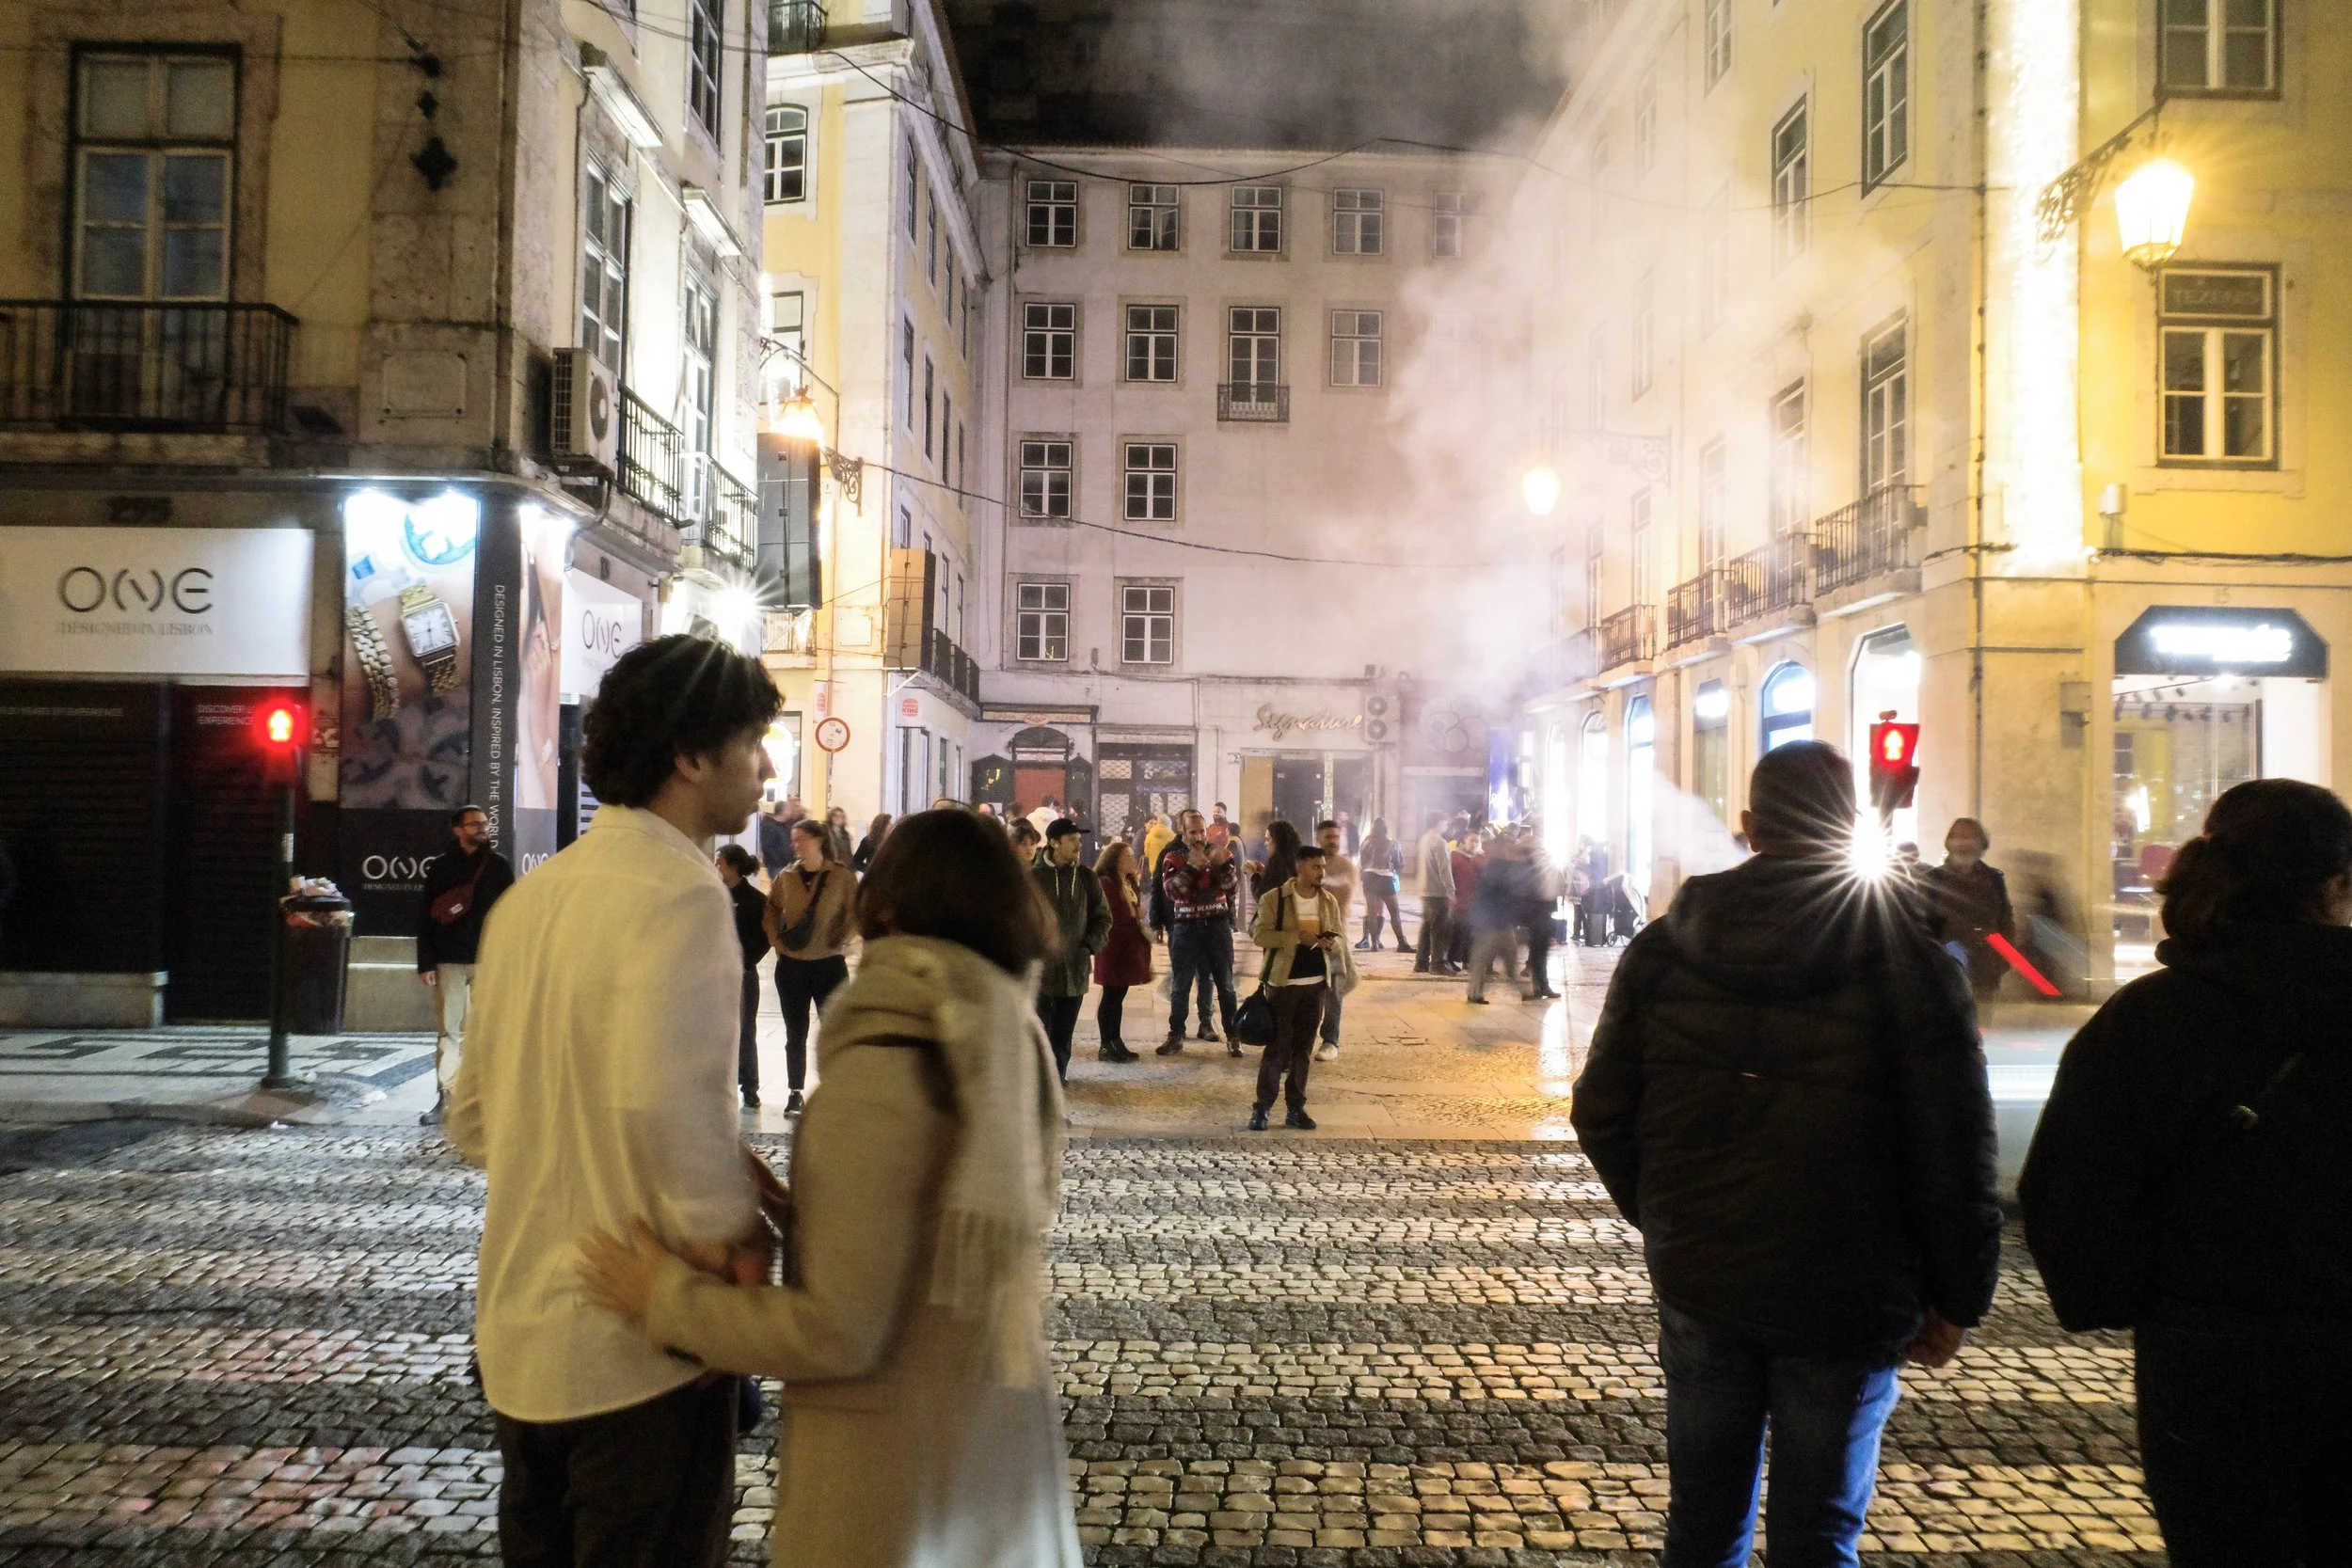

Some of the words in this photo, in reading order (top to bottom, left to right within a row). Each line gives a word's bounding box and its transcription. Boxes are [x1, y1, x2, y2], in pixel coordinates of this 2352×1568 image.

[56, 566, 214, 613] ONE
[492, 584, 505, 643] DESIGNED
[582, 610, 622, 658] ONE
[492, 645, 503, 657] IN
[490, 708, 502, 759] INSPIRED
[489, 762, 501, 776] BY
[489, 781, 500, 801] THE
